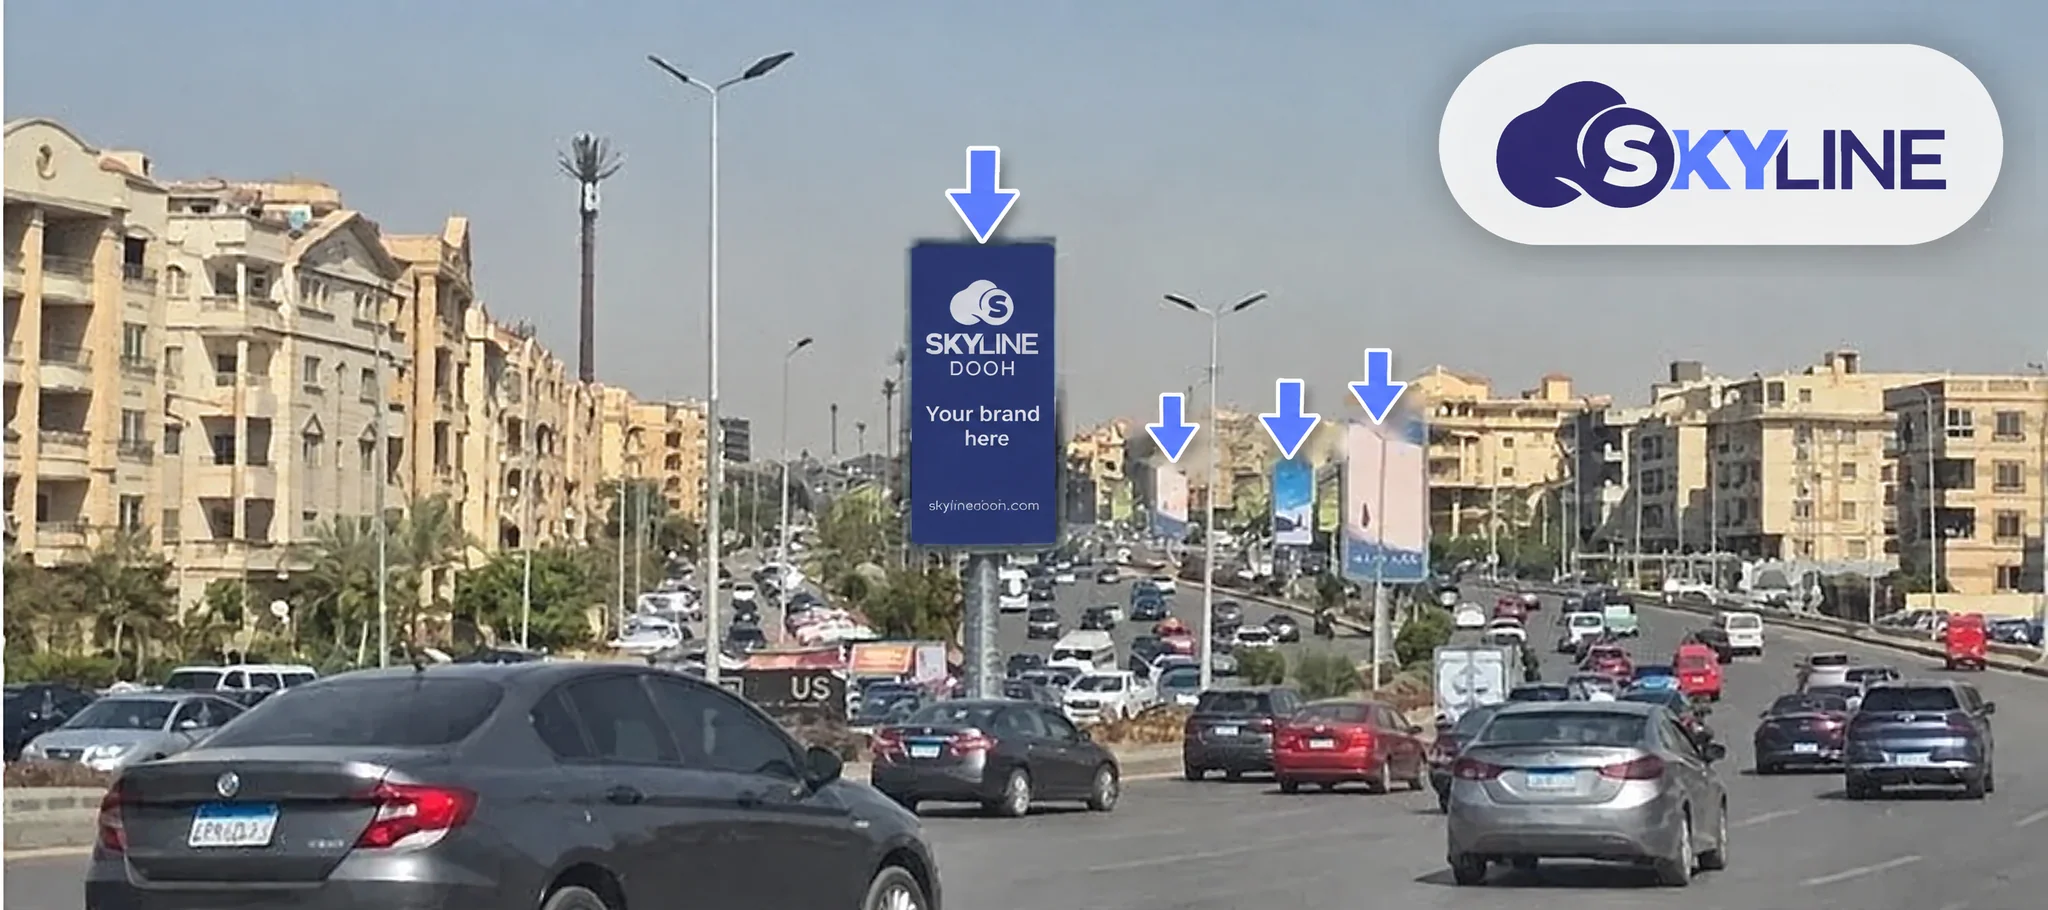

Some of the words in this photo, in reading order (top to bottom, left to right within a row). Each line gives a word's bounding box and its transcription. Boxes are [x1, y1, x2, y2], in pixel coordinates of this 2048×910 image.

[926, 332, 1039, 355] SKYLINE
[950, 360, 1015, 376] DOOH
[926, 405, 974, 422] Your
[980, 405, 1040, 422] brand
[965, 429, 1010, 447] here
